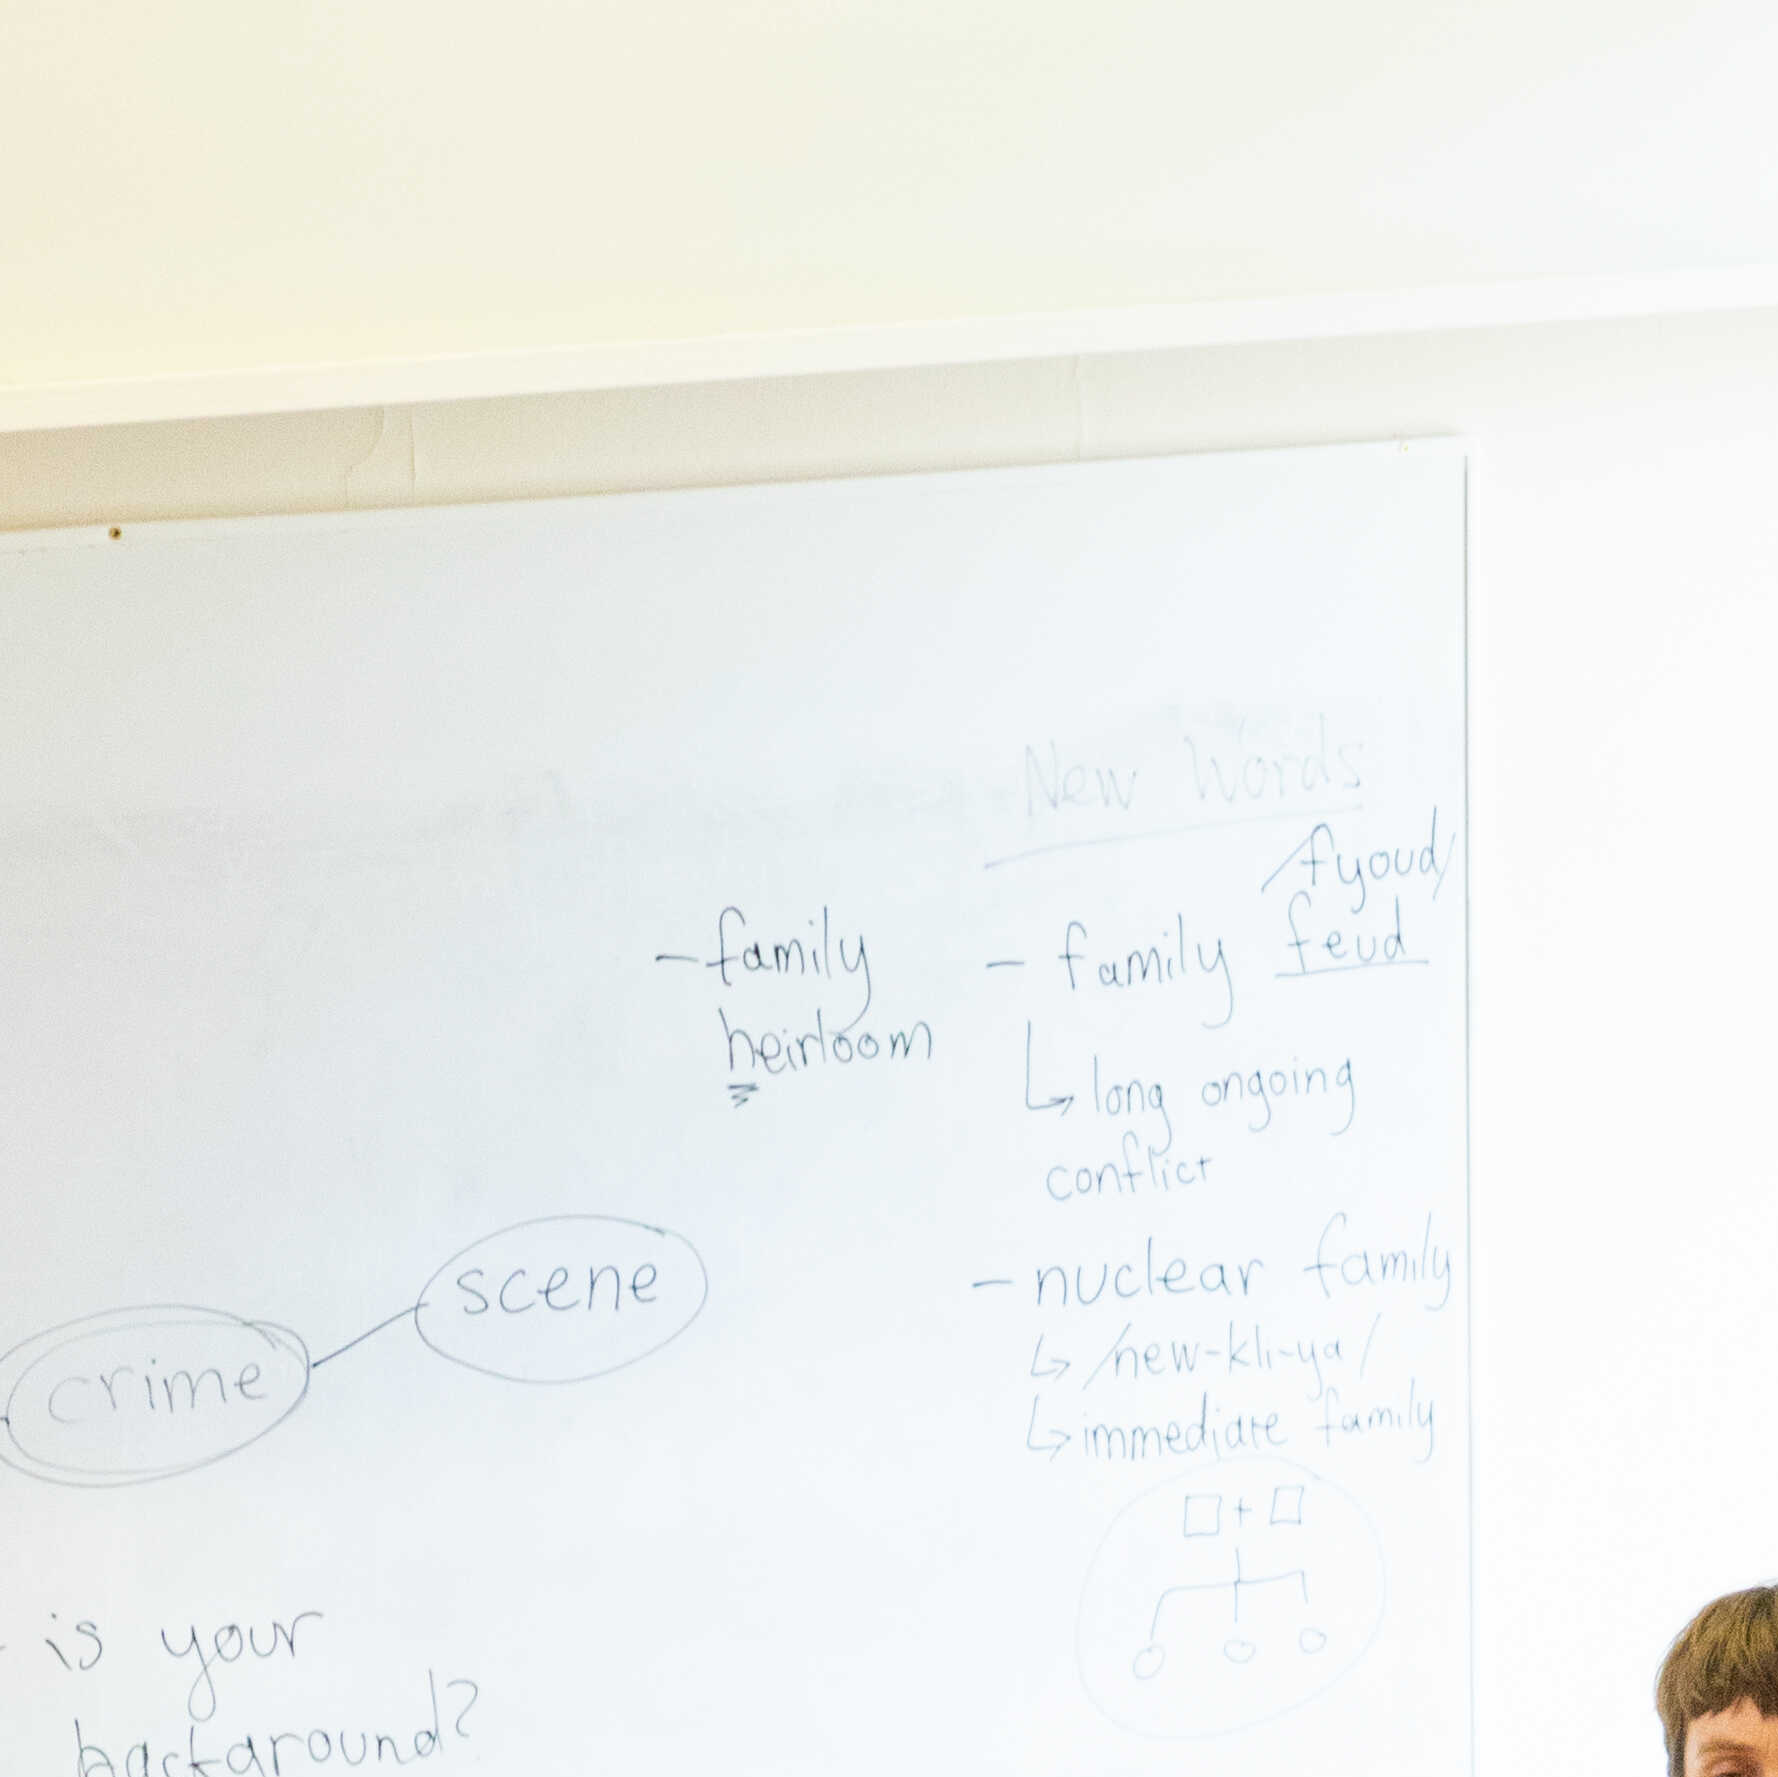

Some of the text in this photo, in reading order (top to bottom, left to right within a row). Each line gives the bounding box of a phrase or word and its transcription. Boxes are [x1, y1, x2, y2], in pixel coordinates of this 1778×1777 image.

[1024, 713, 1365, 818] New Words
[1057, 913, 1233, 1028] family
[1286, 890, 1407, 976] feud
[718, 1007, 932, 1075] heirloom
[1092, 1055, 1356, 1150] long ongoing
[1046, 1131, 1213, 1201] conflict
[456, 1262, 660, 1317] scene
[1036, 1236, 1264, 1306] nuclear
[1303, 1211, 1451, 1312] family
[48, 1357, 270, 1425] crime
[1084, 1377, 1436, 1464] immediate family
[45, 1610, 324, 1722] is your
